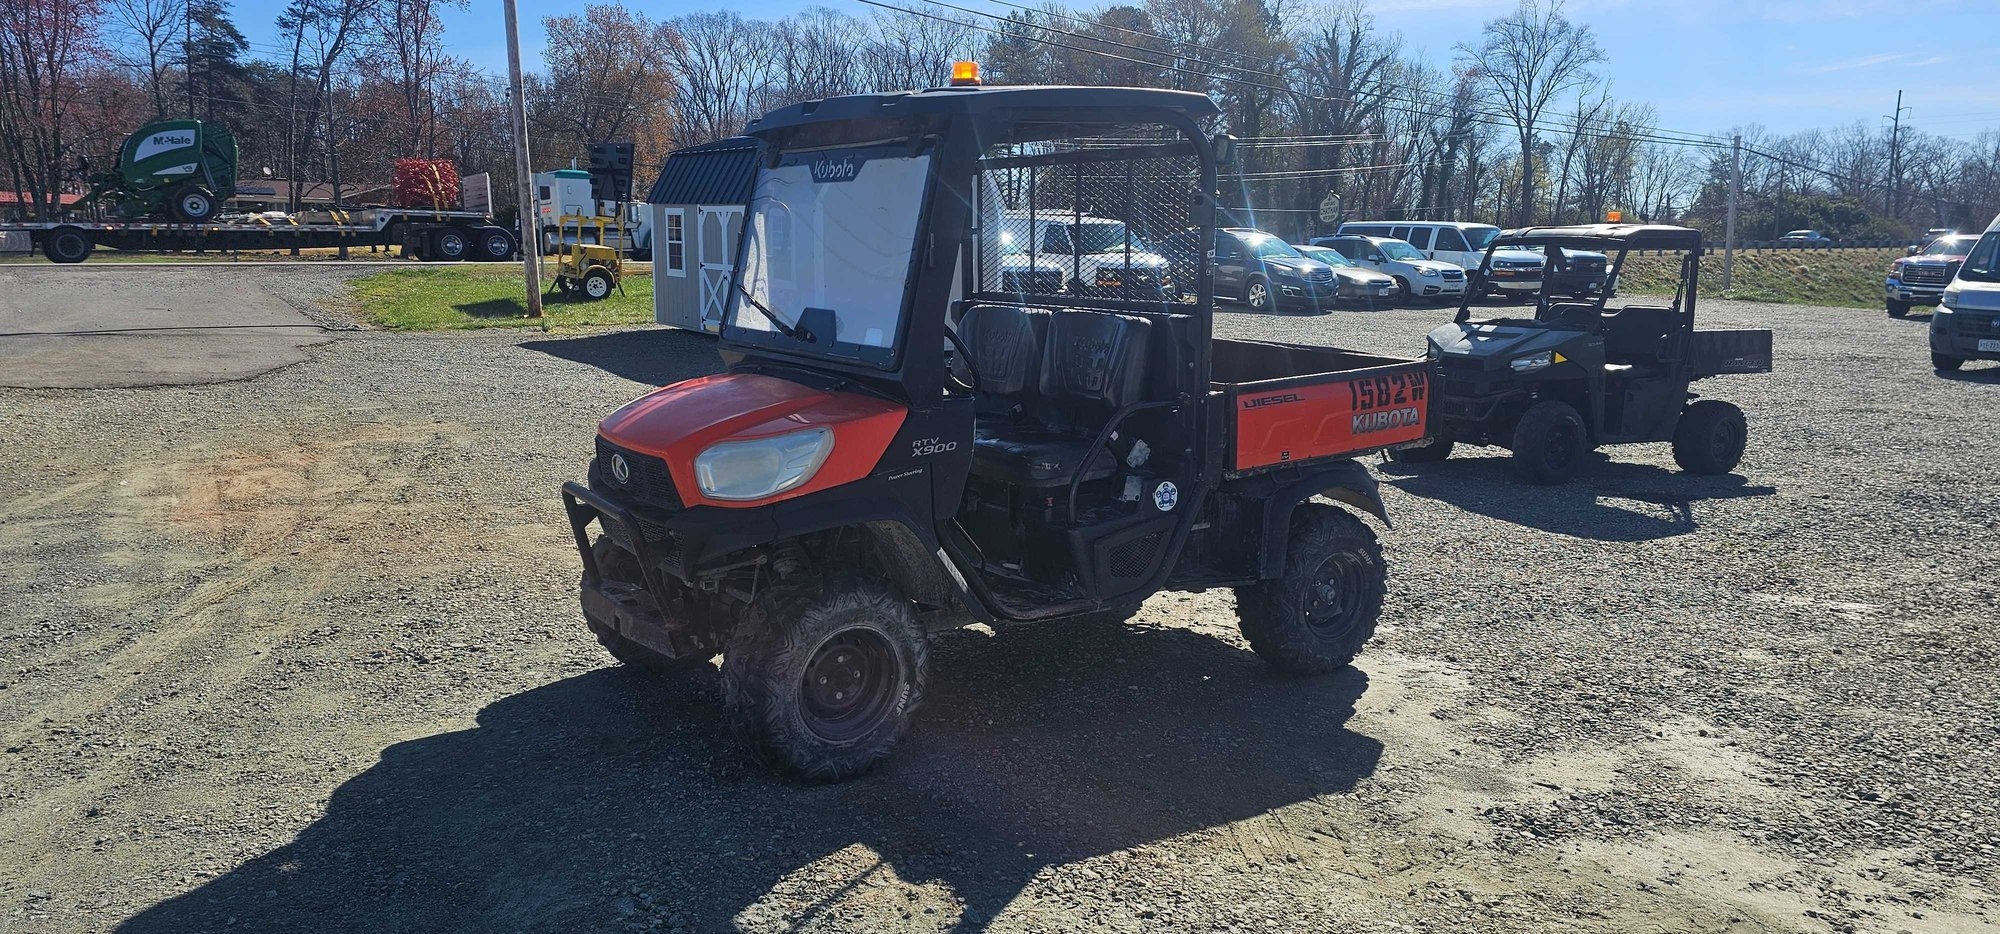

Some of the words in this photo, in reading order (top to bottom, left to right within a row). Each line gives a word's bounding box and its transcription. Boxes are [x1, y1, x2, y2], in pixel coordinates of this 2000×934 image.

[814, 159, 854, 178] Kubota
[1243, 393, 1305, 408] DIESEL
[1352, 407, 1420, 434] KUBOTA
[912, 437, 940, 448] RTV
[912, 441, 957, 456] X900
[888, 472, 903, 480] Power
[903, 468, 923, 477] Steering
